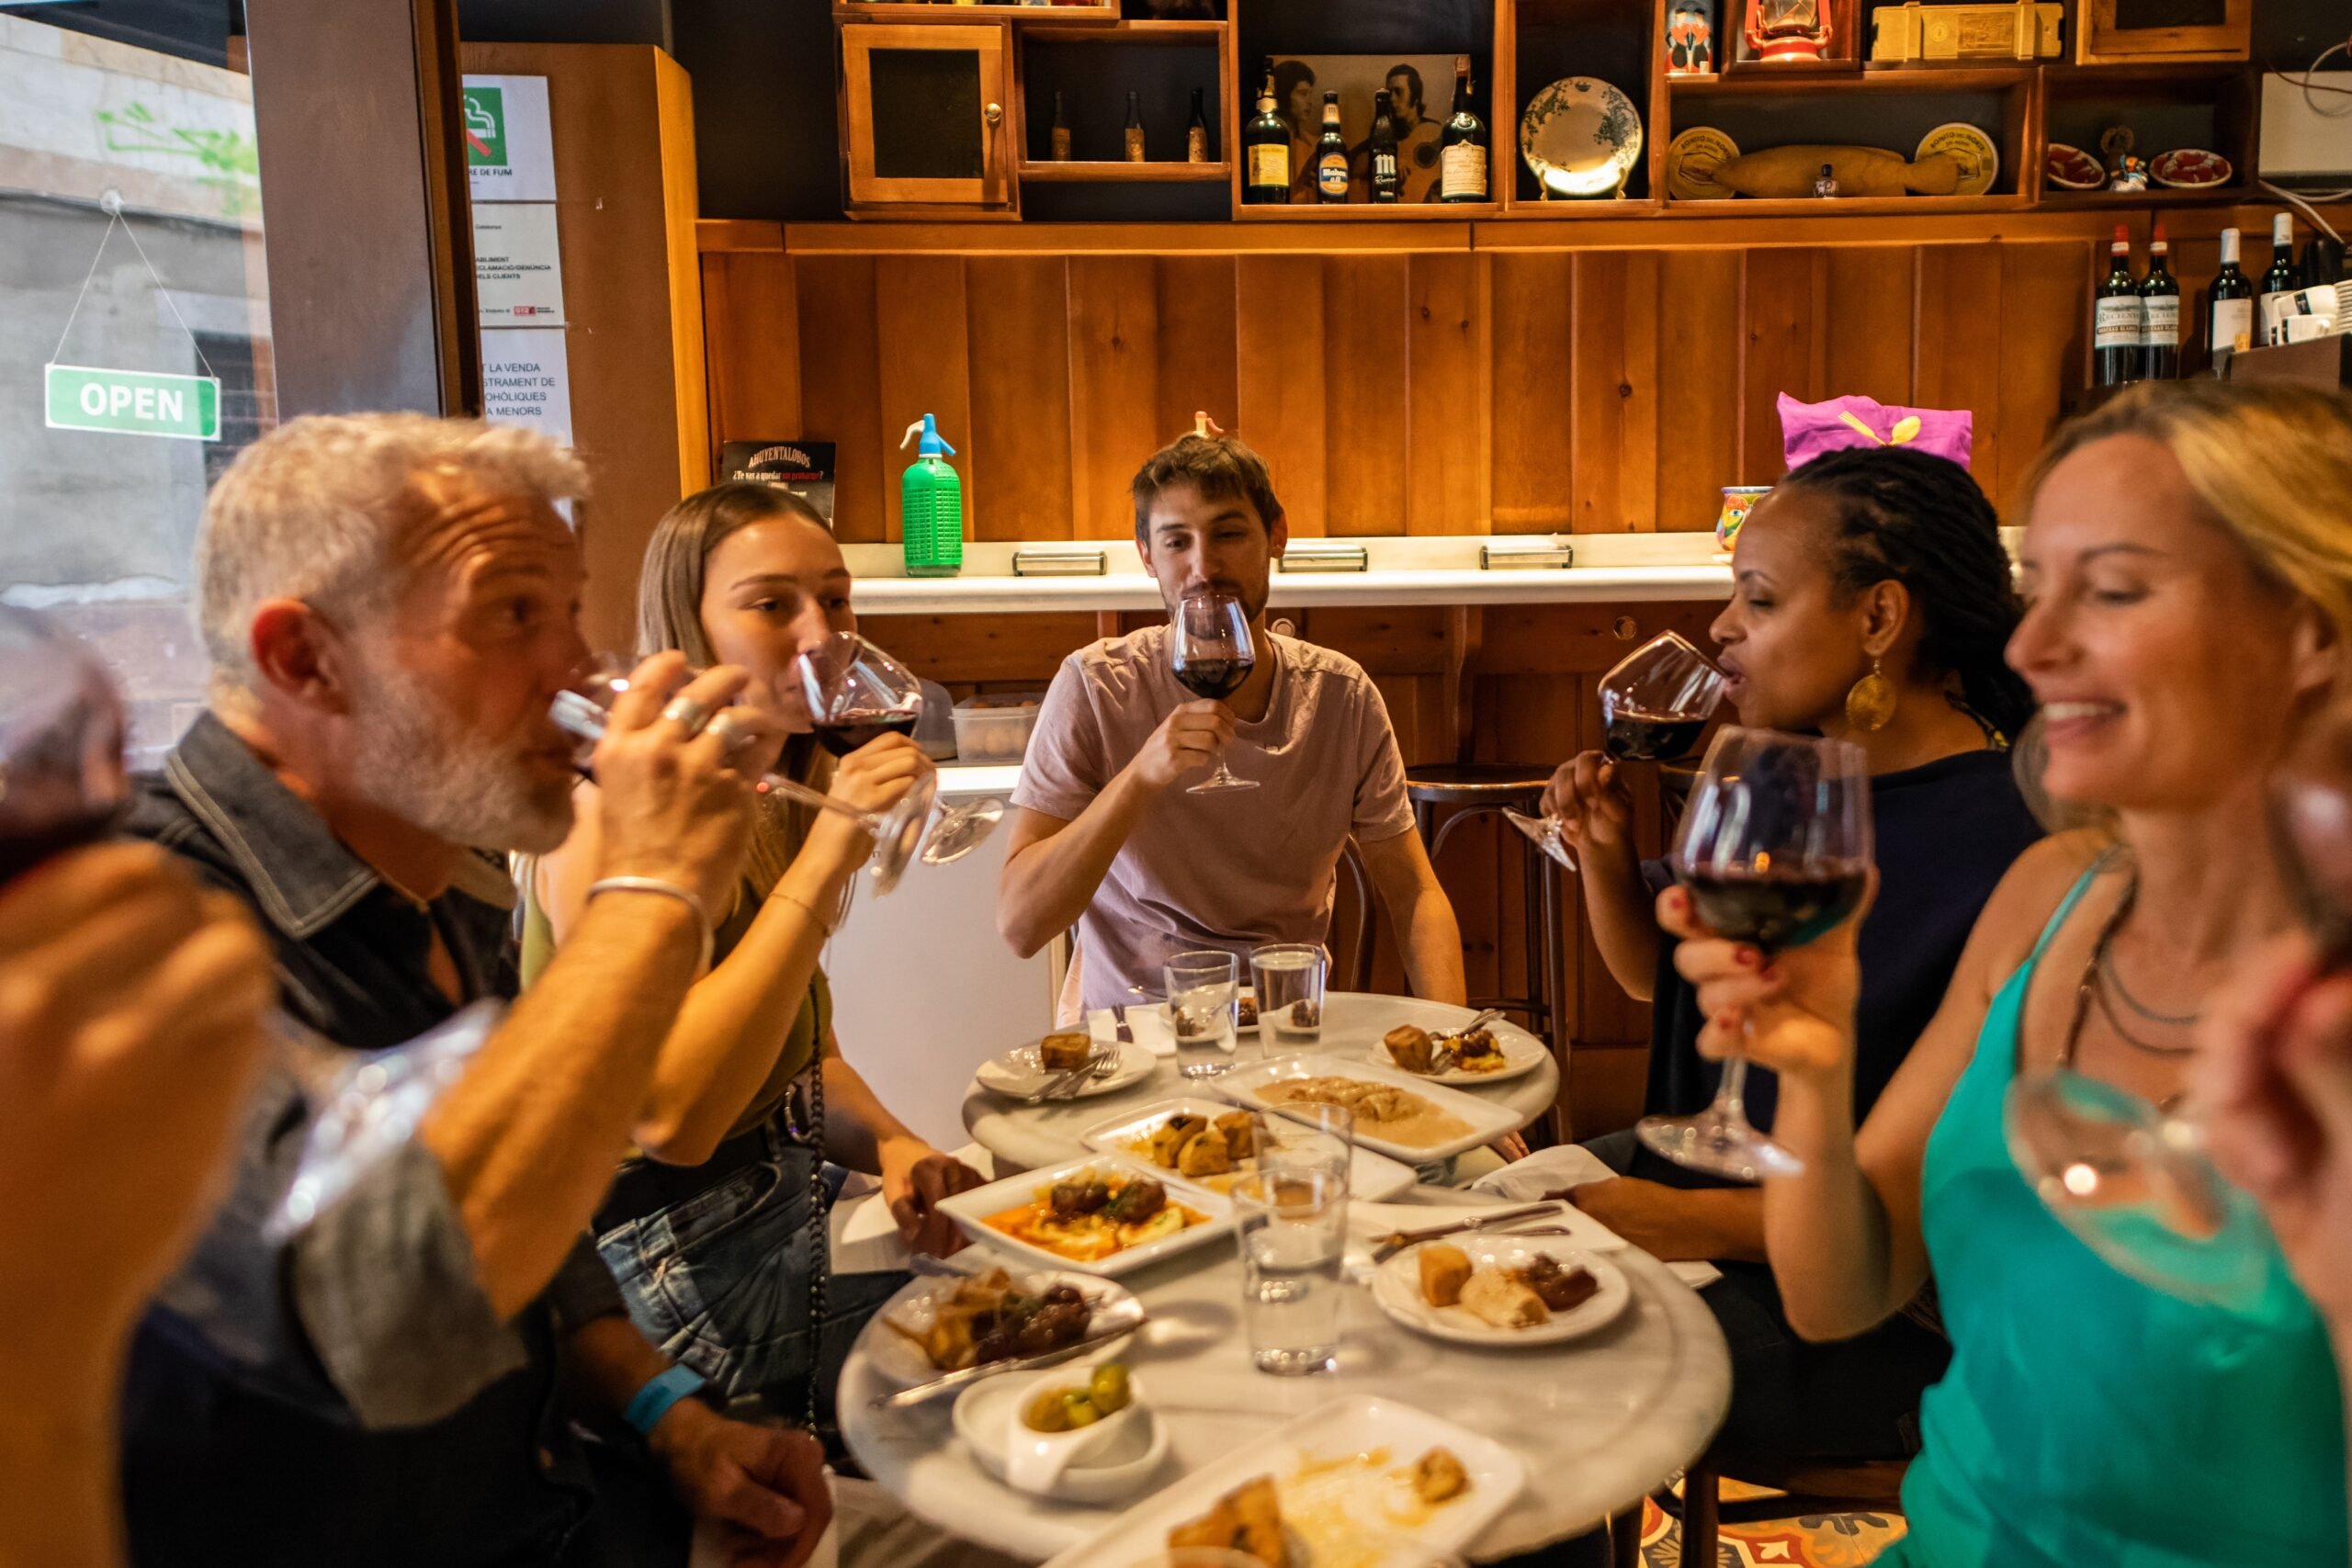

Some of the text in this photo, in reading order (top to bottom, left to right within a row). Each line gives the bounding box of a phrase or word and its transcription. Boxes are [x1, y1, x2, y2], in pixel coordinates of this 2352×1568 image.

[492, 168, 513, 176] FUM
[490, 364, 503, 373] LA
[504, 364, 540, 372] VENDA
[540, 378, 556, 387] DE
[80, 382, 183, 423] OPEN
[486, 406, 542, 415] A MENORS
[748, 446, 810, 468] AHUYENTALOBOS
[761, 470, 781, 481] quedar
